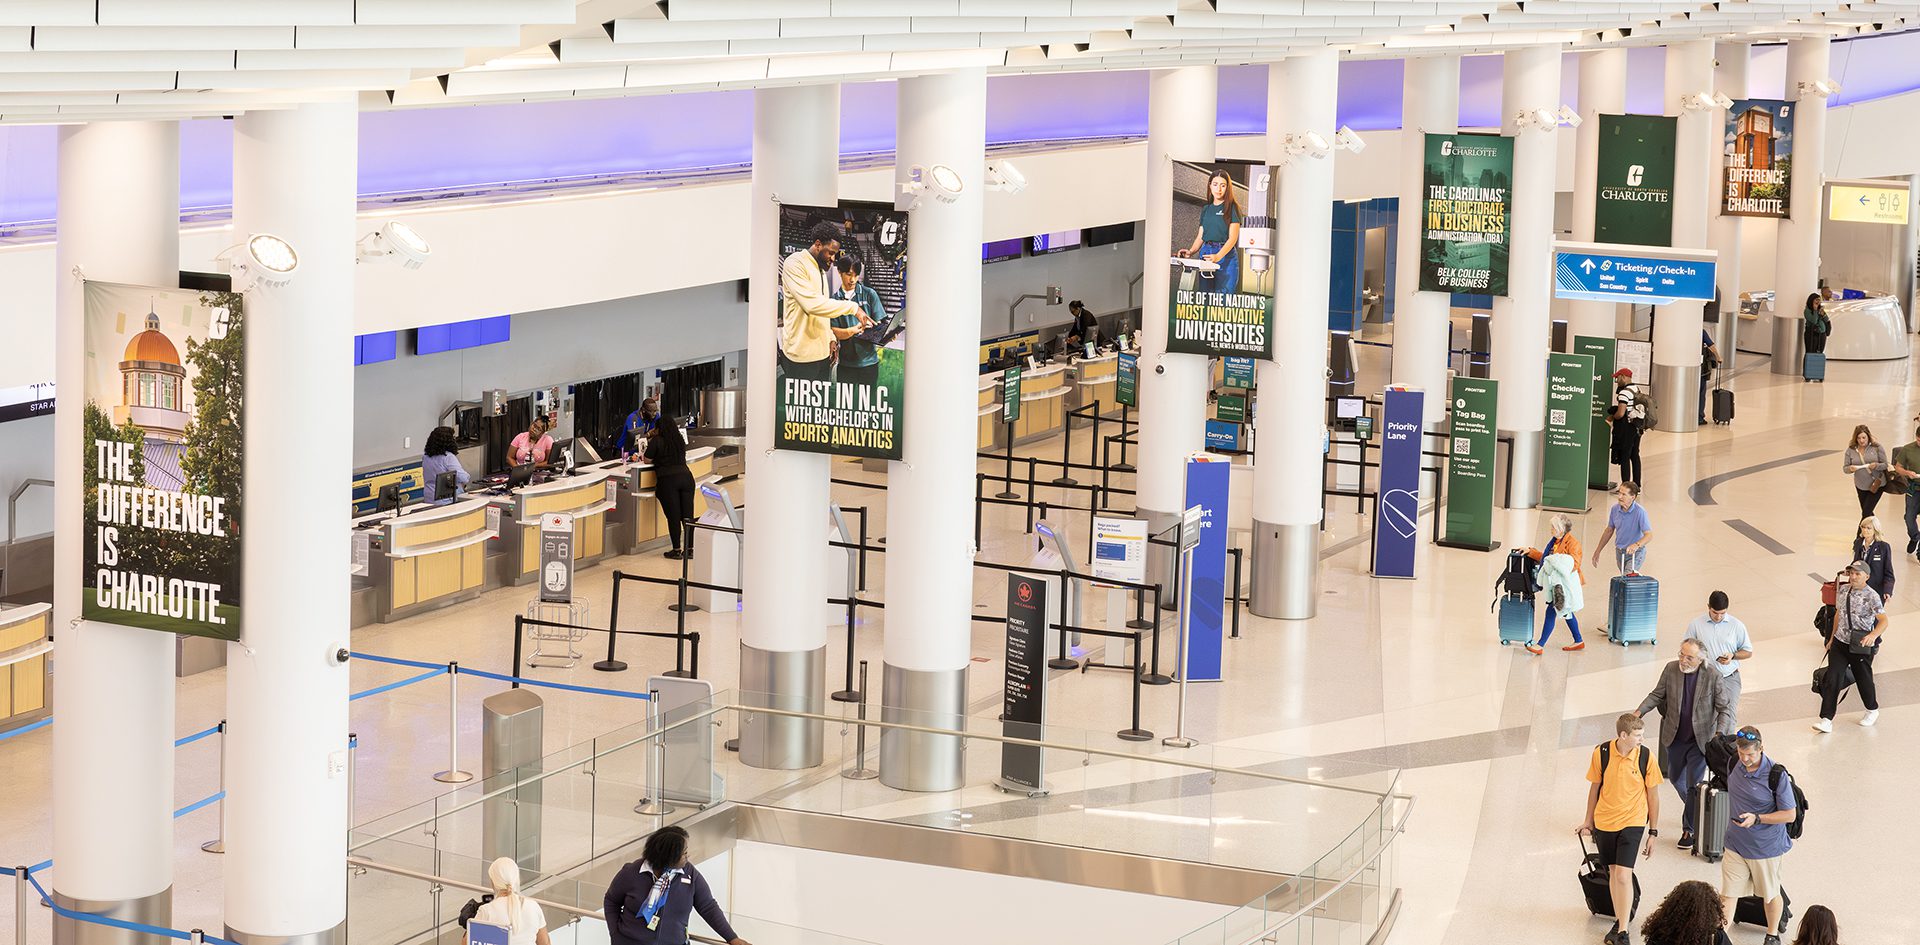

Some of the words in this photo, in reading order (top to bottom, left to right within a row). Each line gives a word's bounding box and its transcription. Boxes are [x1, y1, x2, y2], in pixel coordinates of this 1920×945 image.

[1452, 148, 1497, 156] CHARLOTTE
[1729, 154, 1746, 167] THE
[1730, 168, 1785, 184] DIFFERENCE
[1430, 186, 1446, 200] THE
[1602, 190, 1667, 202] CHARLOTTE
[1729, 183, 1738, 196] IS
[1429, 200, 1452, 213] FIRST
[1455, 201, 1504, 216] DOCTORATE
[1728, 197, 1784, 213] CHARLOTTE.
[1428, 213, 1440, 229] IN
[1444, 214, 1504, 233] BUSINESS
[1428, 231, 1482, 243] ADMINISTRATION
[1484, 234, 1503, 244] (DBA)
[1438, 267, 1456, 277] BELK
[1458, 269, 1490, 280] COLLEGE
[1439, 276, 1449, 286] OF
[1450, 278, 1488, 288] BUSINESS
[1177, 290, 1194, 304] ONE
[1196, 292, 1207, 305] OF
[1208, 293, 1224, 307] THE
[1177, 304, 1204, 321] MOST
[1207, 306, 1264, 325] INNOVATIVE
[1176, 320, 1264, 346] UNIVERSITIES
[785, 378, 831, 408] FIRST
[836, 382, 853, 410] IN
[858, 384, 893, 413] N.C.
[1552, 384, 1585, 394] Checking
[1552, 392, 1572, 400] Bags?
[30, 401, 48, 411] STAR
[785, 405, 812, 423] WITH
[882, 414, 893, 430] IN
[1456, 410, 1469, 418] Tag
[1471, 412, 1485, 420] Bag
[1388, 422, 1418, 432] Priority
[784, 422, 828, 443] SPORTS
[831, 426, 892, 450] ANALYTICS
[1207, 432, 1233, 440] Carry-On
[1387, 432, 1406, 440] Lane
[95, 439, 134, 482] THE
[97, 483, 225, 537] DIFFERENCE
[97, 526, 118, 566] IS
[97, 568, 226, 624] CHARLOTTE.
[1010, 617, 1025, 626] PRIORITY
